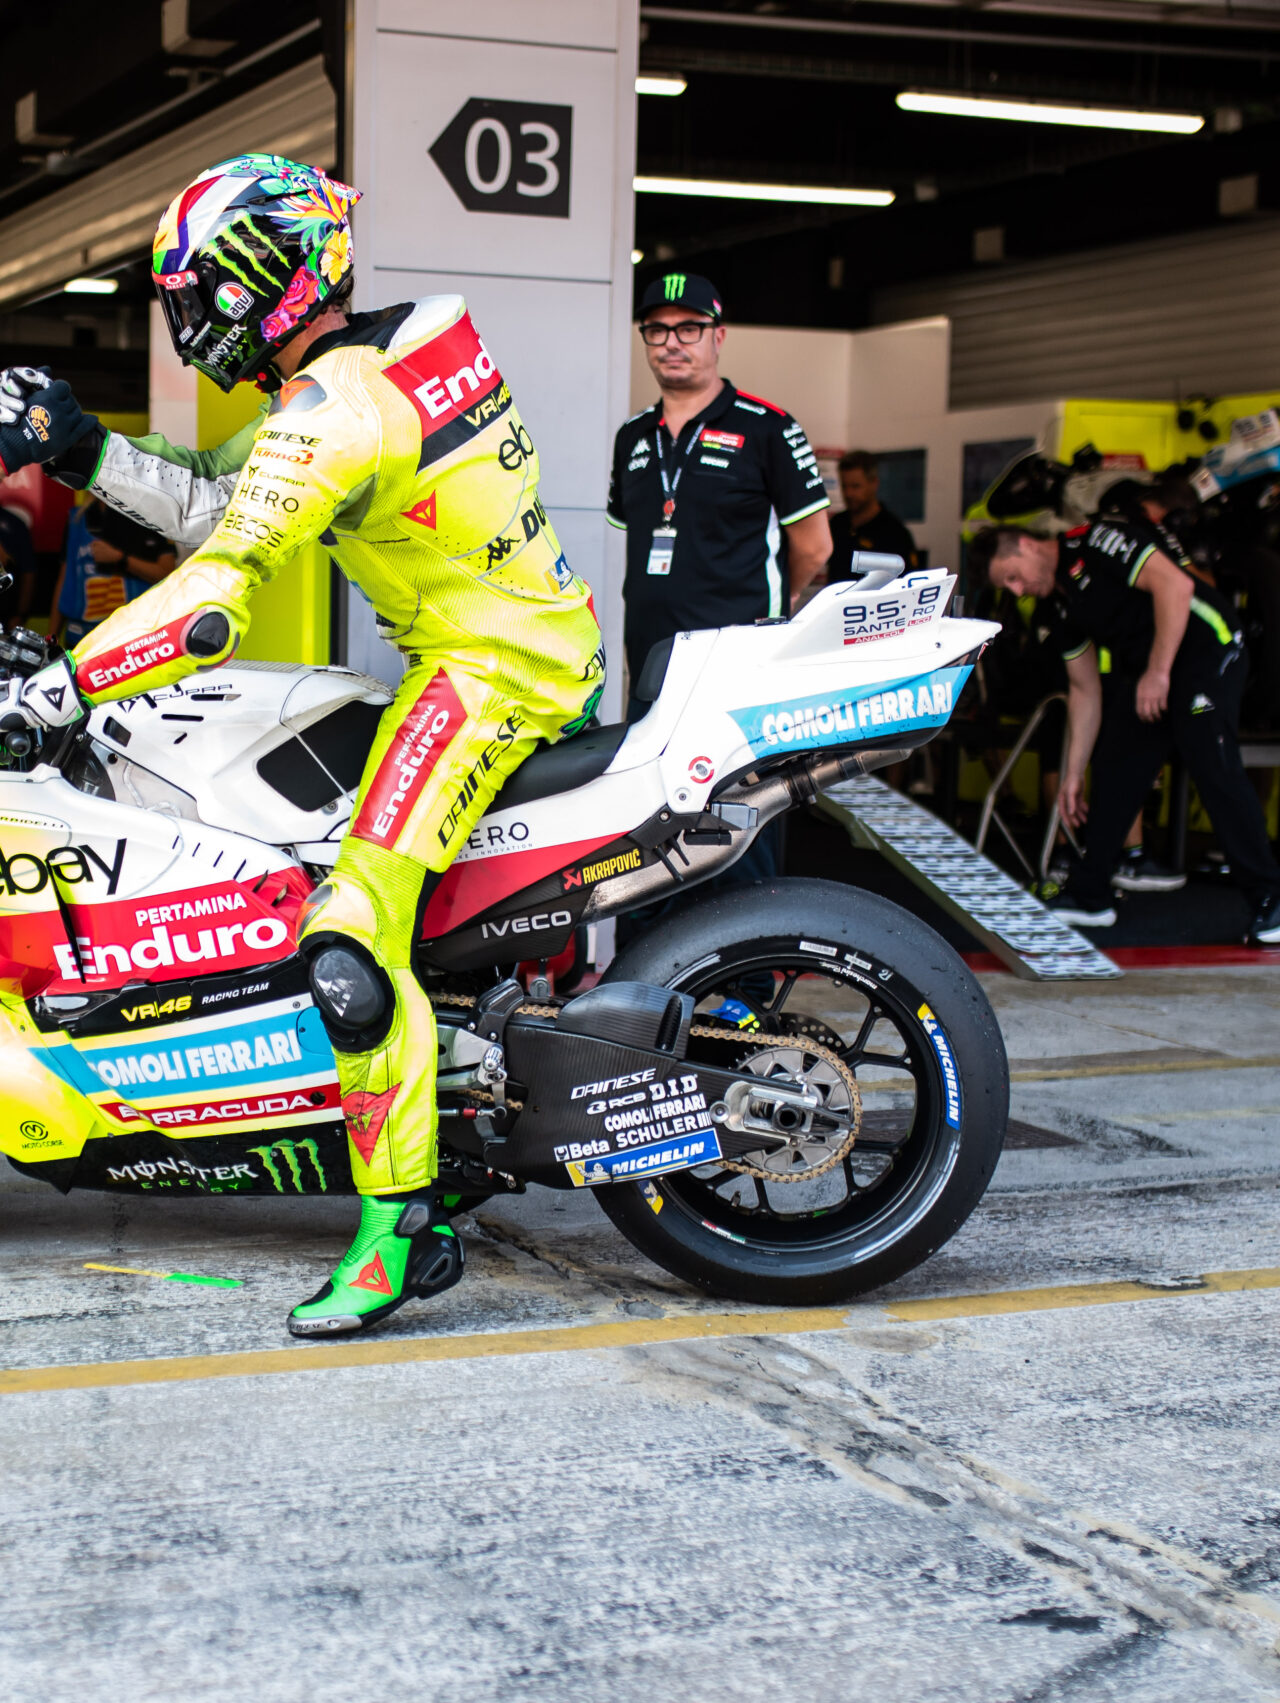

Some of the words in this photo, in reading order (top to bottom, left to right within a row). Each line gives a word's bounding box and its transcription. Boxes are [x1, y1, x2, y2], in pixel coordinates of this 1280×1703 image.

[464, 117, 561, 196] 03
[229, 295, 250, 318] agv
[205, 324, 248, 367] MONSTER
[413, 338, 496, 420] End
[258, 430, 322, 448] DAINESE
[498, 420, 534, 472] eb
[258, 471, 306, 487] CUPRA
[239, 482, 300, 513] HERO
[124, 629, 169, 655] PERTAMINA
[88, 642, 176, 688] Enduro
[152, 683, 233, 701] CUPRA
[761, 701, 856, 746] COMOLI
[856, 681, 953, 727] FERRARI
[394, 703, 437, 767] PERTAMINA
[371, 709, 450, 839] Enduro
[437, 707, 526, 850] DAINESE
[467, 821, 530, 850] ERO
[476, 843, 534, 857] INNOVATION
[135, 892, 247, 927] PERTAMINA
[481, 910, 572, 939] IVECO
[52, 917, 288, 981] Enduro
[201, 988, 240, 1006] RACING
[241, 981, 270, 996] TEAM
[87, 1050, 187, 1088] OMOLI
[185, 1028, 303, 1078] FERRARI
[570, 1067, 657, 1100] DAINESE
[933, 1034, 960, 1122] MICHELIN
[118, 1094, 315, 1126] BRRACUDA
[604, 1106, 653, 1132] COMOLI
[651, 1093, 708, 1120] FERRARI
[608, 1091, 647, 1109] RCB
[615, 1115, 698, 1148] SCHULER
[569, 1138, 611, 1159] Beta
[611, 1141, 706, 1175] MICHELIN
[107, 1156, 259, 1183] MONSTER
